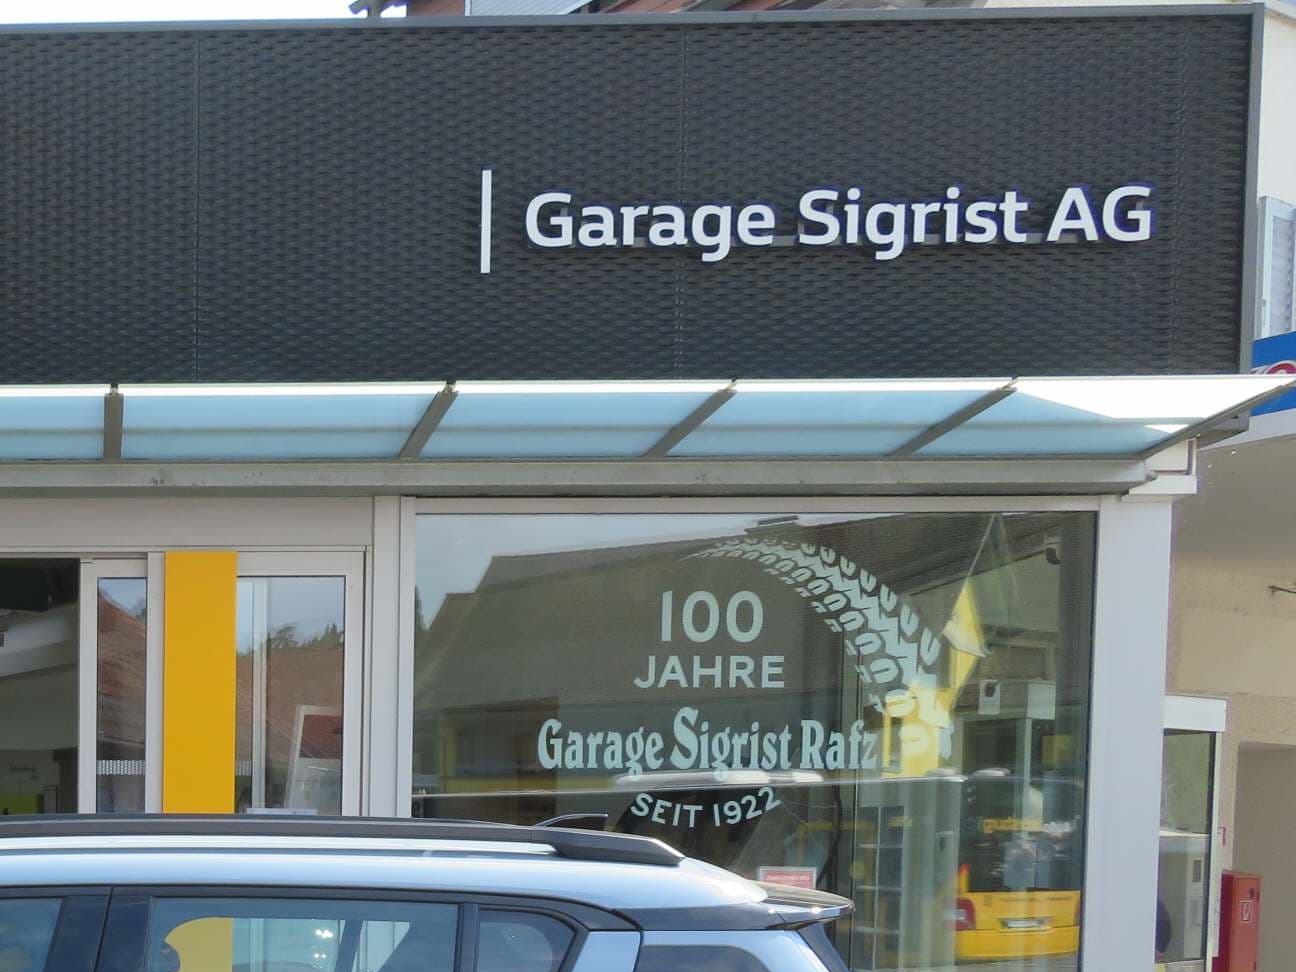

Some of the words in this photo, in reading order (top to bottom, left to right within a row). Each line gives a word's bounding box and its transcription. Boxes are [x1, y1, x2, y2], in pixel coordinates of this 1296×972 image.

[524, 192, 776, 262] Garage
[797, 186, 1029, 261] Sigrist
[1043, 185, 1153, 243] AG
[659, 589, 764, 643] 100
[632, 654, 786, 689] JAHRE
[536, 717, 665, 781] Garage
[669, 706, 792, 781] Sigrist
[799, 718, 878, 771] Rafz
[629, 792, 704, 829] SEIT
[712, 785, 782, 828] 1922
